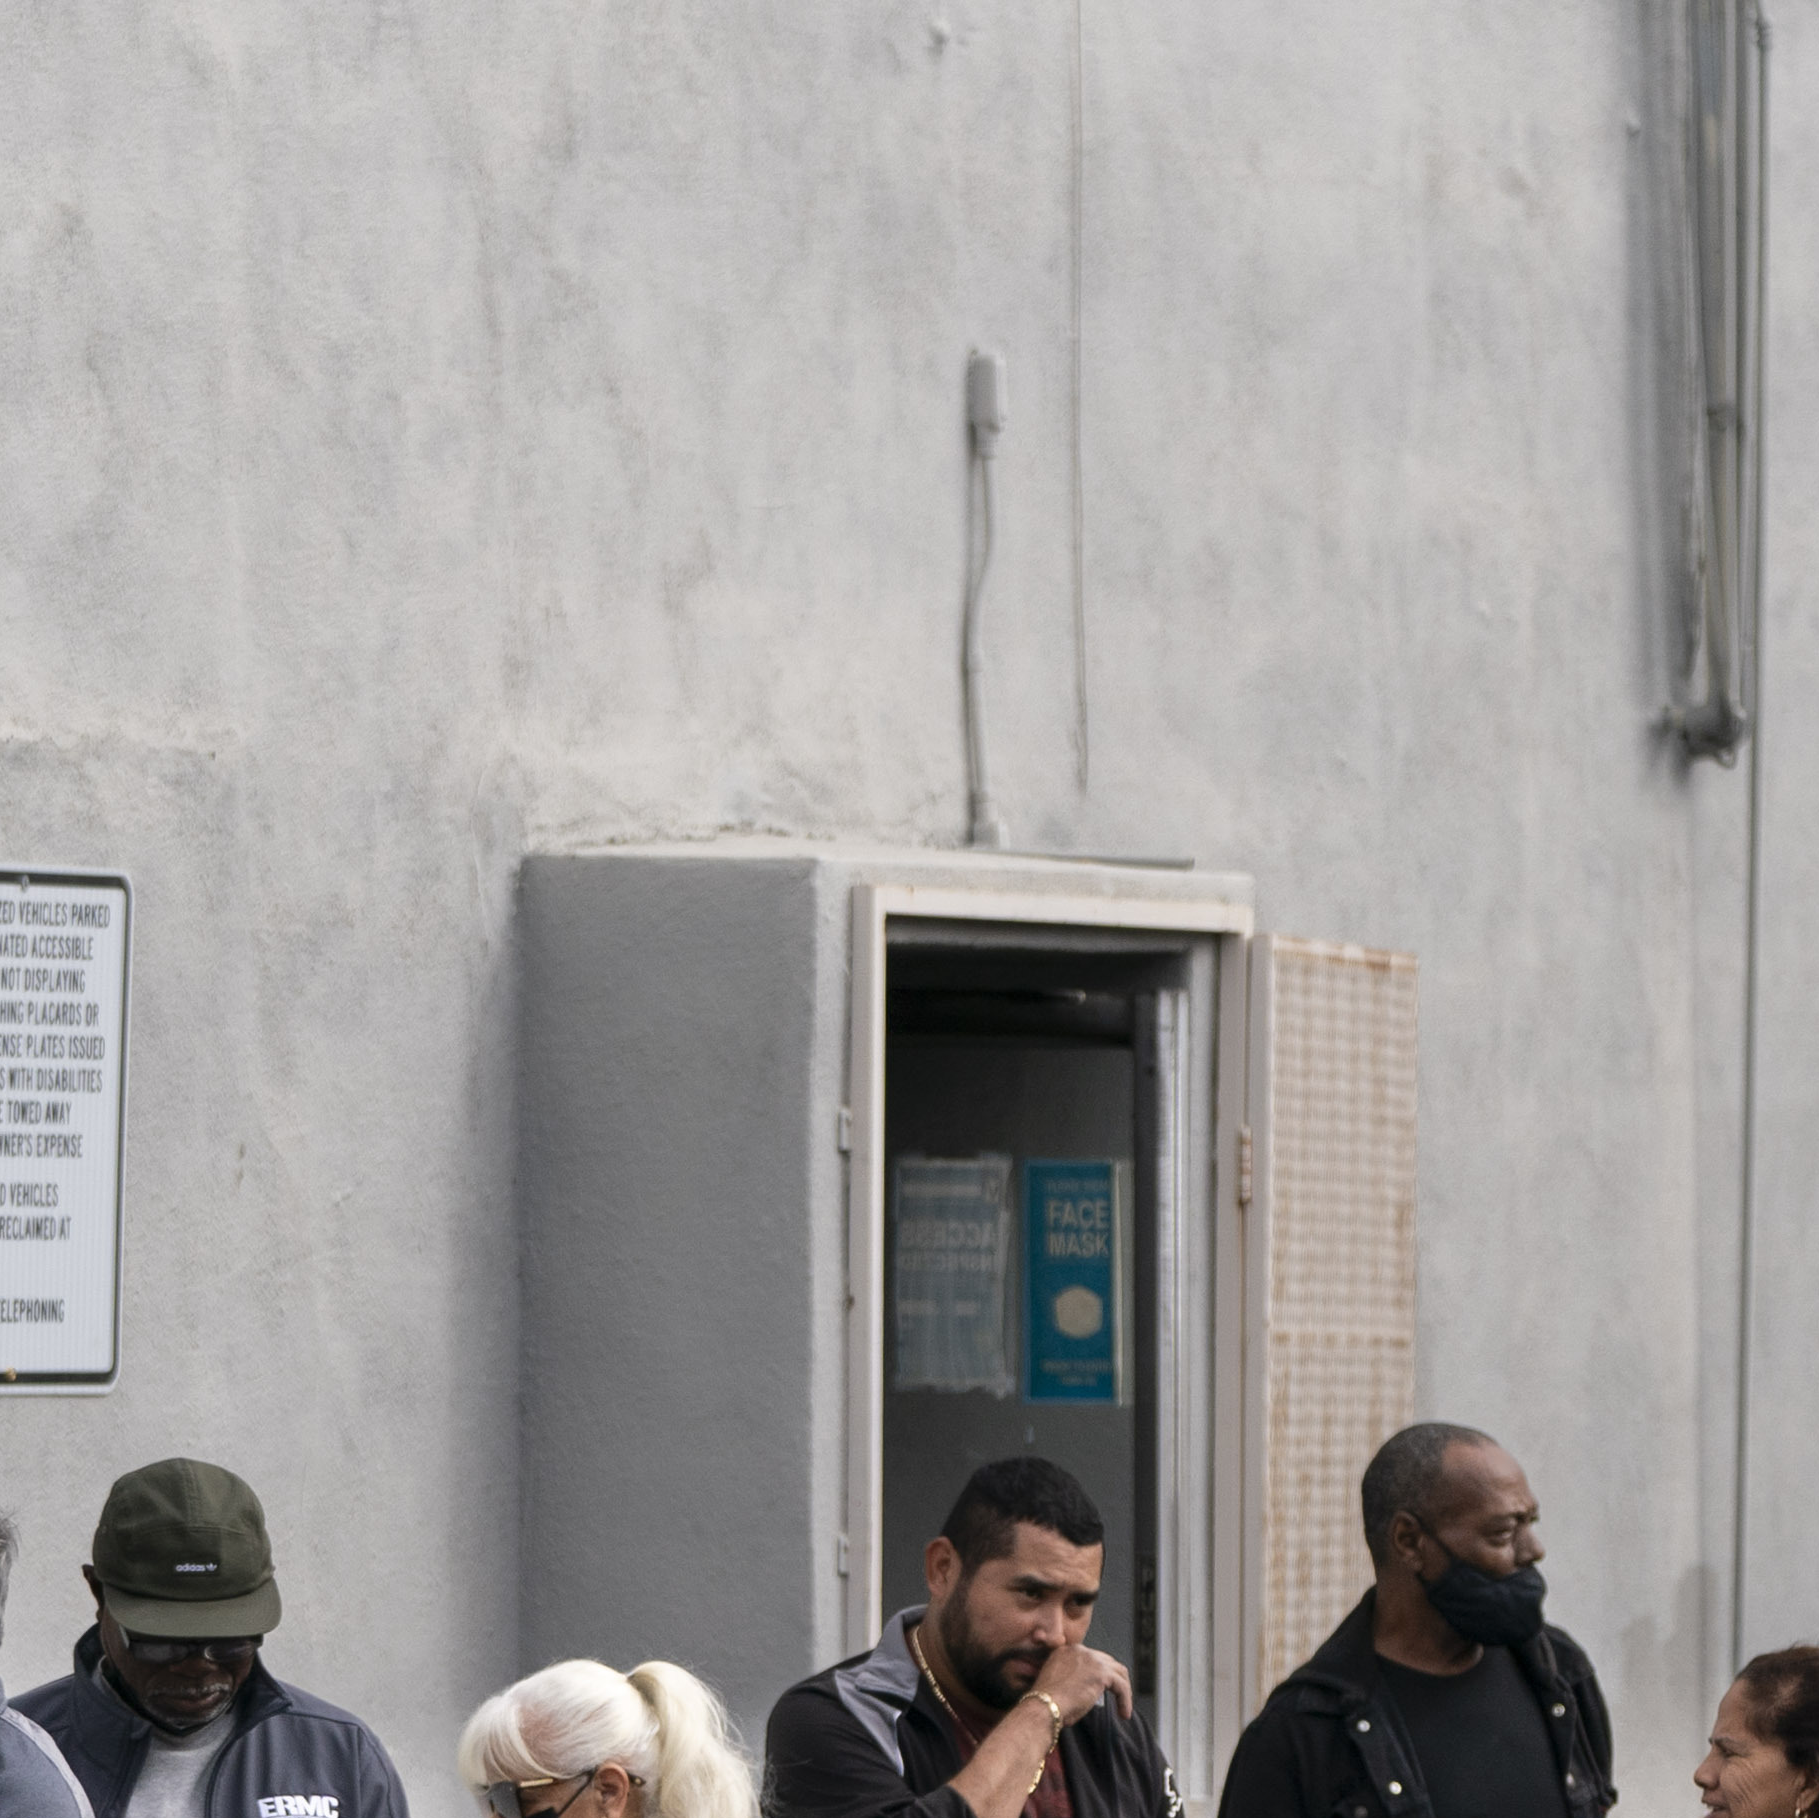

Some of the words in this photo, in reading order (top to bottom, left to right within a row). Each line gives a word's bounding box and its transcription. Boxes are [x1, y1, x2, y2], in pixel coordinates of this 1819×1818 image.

[19, 900, 68, 926] VEHICLES
[71, 903, 110, 928] PARKED
[32, 935, 93, 960] ACCESSIBLE
[1, 968, 21, 991] NOT
[25, 968, 85, 993] DISPLAYING
[28, 1001, 82, 1026] PLACARDS
[85, 1004, 99, 1026] OR
[26, 1035, 65, 1059] PLATES
[69, 1037, 105, 1060] ISSUED
[9, 1068, 33, 1091] WITH
[37, 1069, 102, 1092] DISABILITIES
[8, 1101, 41, 1124] TOWED
[45, 1102, 71, 1125] AWAY
[37, 1135, 82, 1158] EXPENSE
[10, 1183, 59, 1207] VEHICLES
[1047, 1199, 1109, 1230] FACE
[60, 1218, 71, 1240] AT
[1048, 1231, 1109, 1257] MASK
[176, 1563, 205, 1572] adidas
